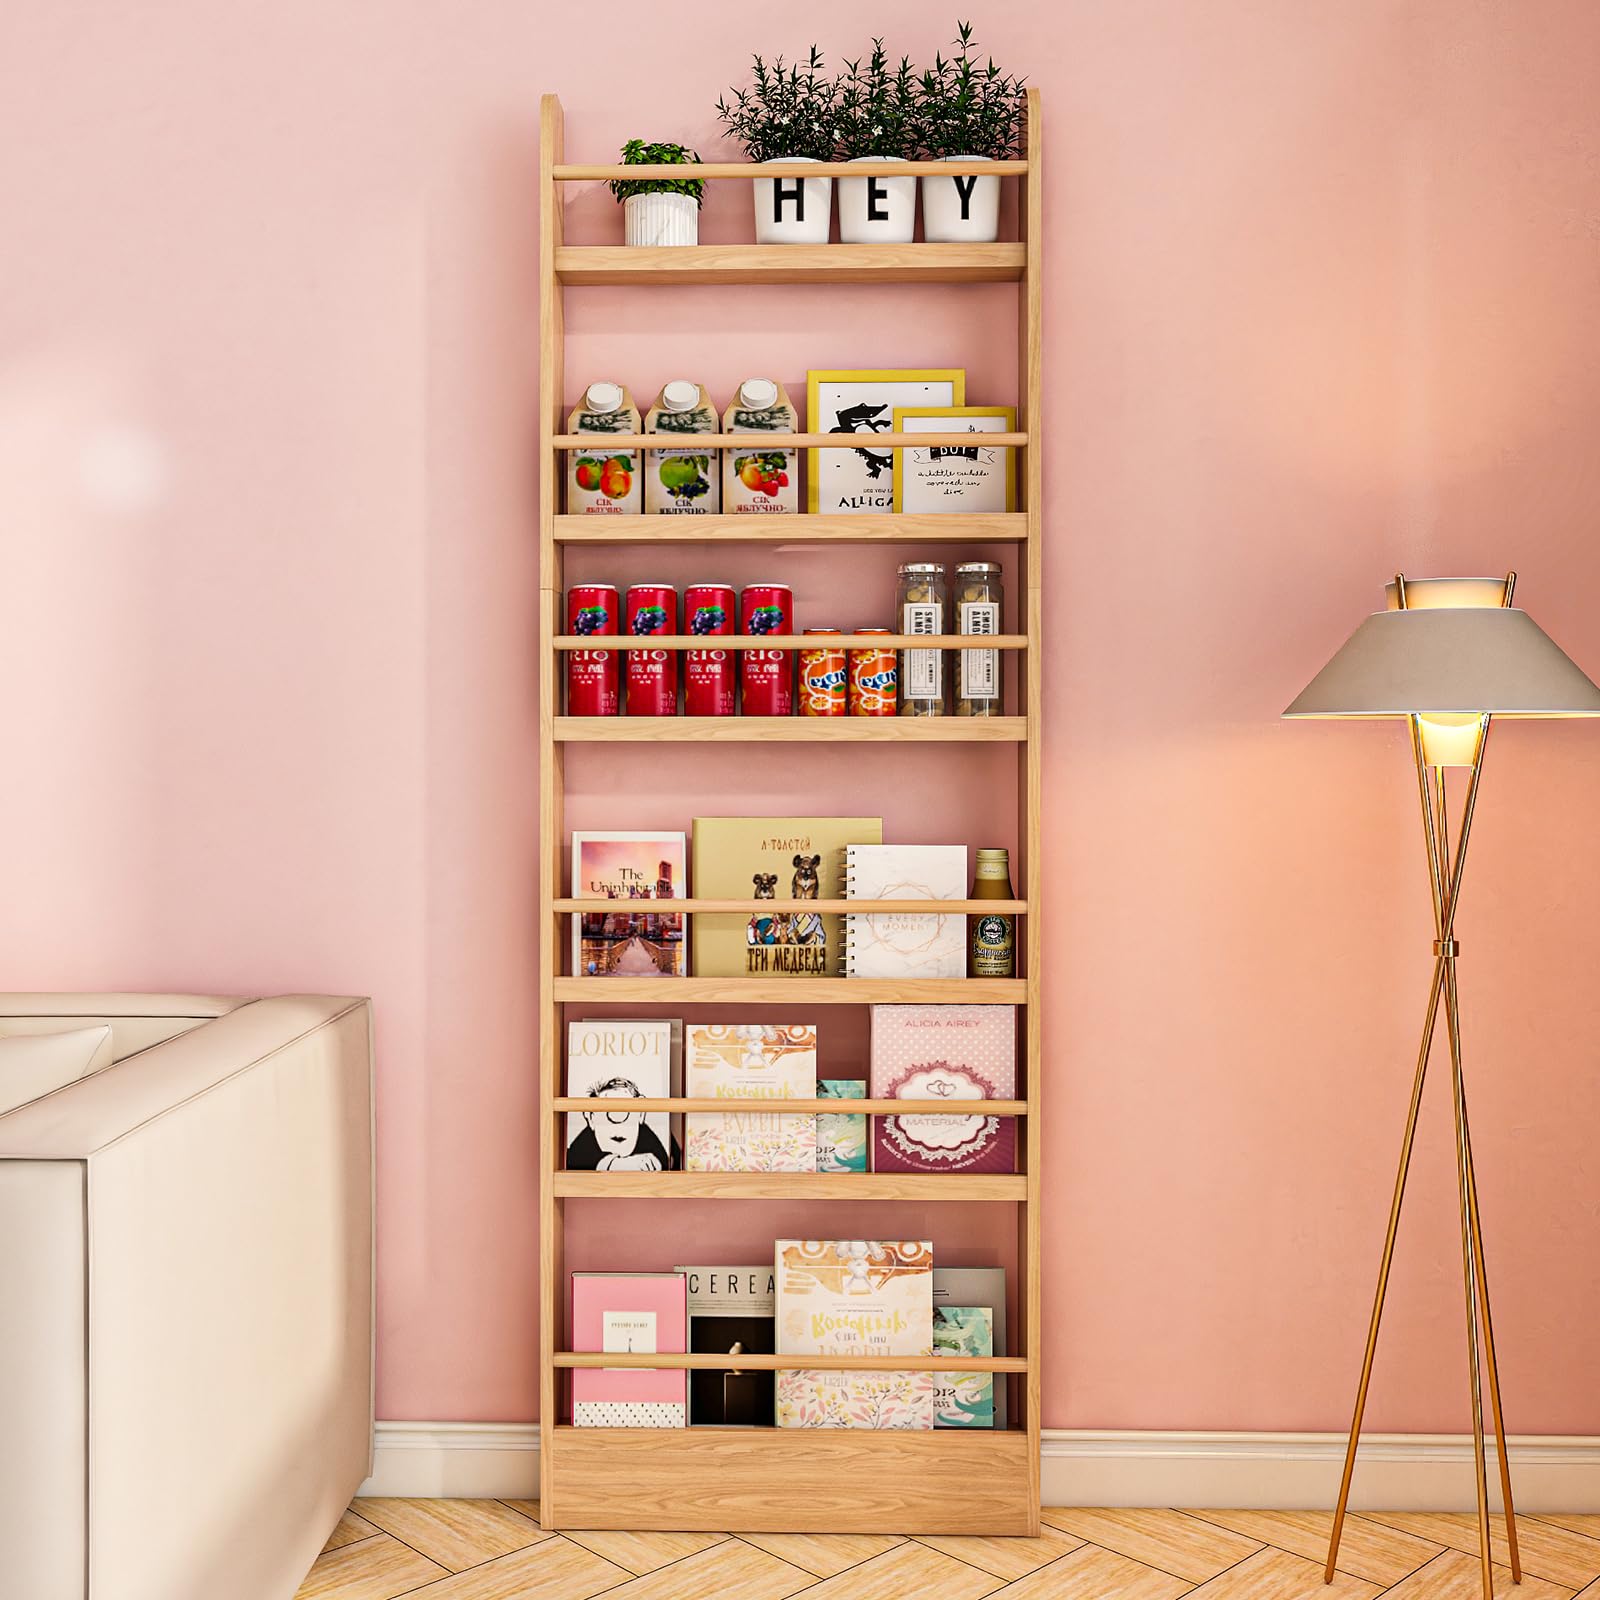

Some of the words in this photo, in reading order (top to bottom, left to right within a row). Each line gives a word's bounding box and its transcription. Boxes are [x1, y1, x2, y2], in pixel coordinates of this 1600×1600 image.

[618, 868, 644, 880] The
[747, 948, 768, 972] ТРИ
[773, 948, 826, 974] МЕДВЕДЯ
[904, 1020, 942, 1028] ALICIA
[945, 1020, 981, 1028] AIREY
[569, 1032, 666, 1056] LORIOT
[906, 1118, 966, 1126] MATERIAL
[690, 1274, 775, 1294] CEREA
